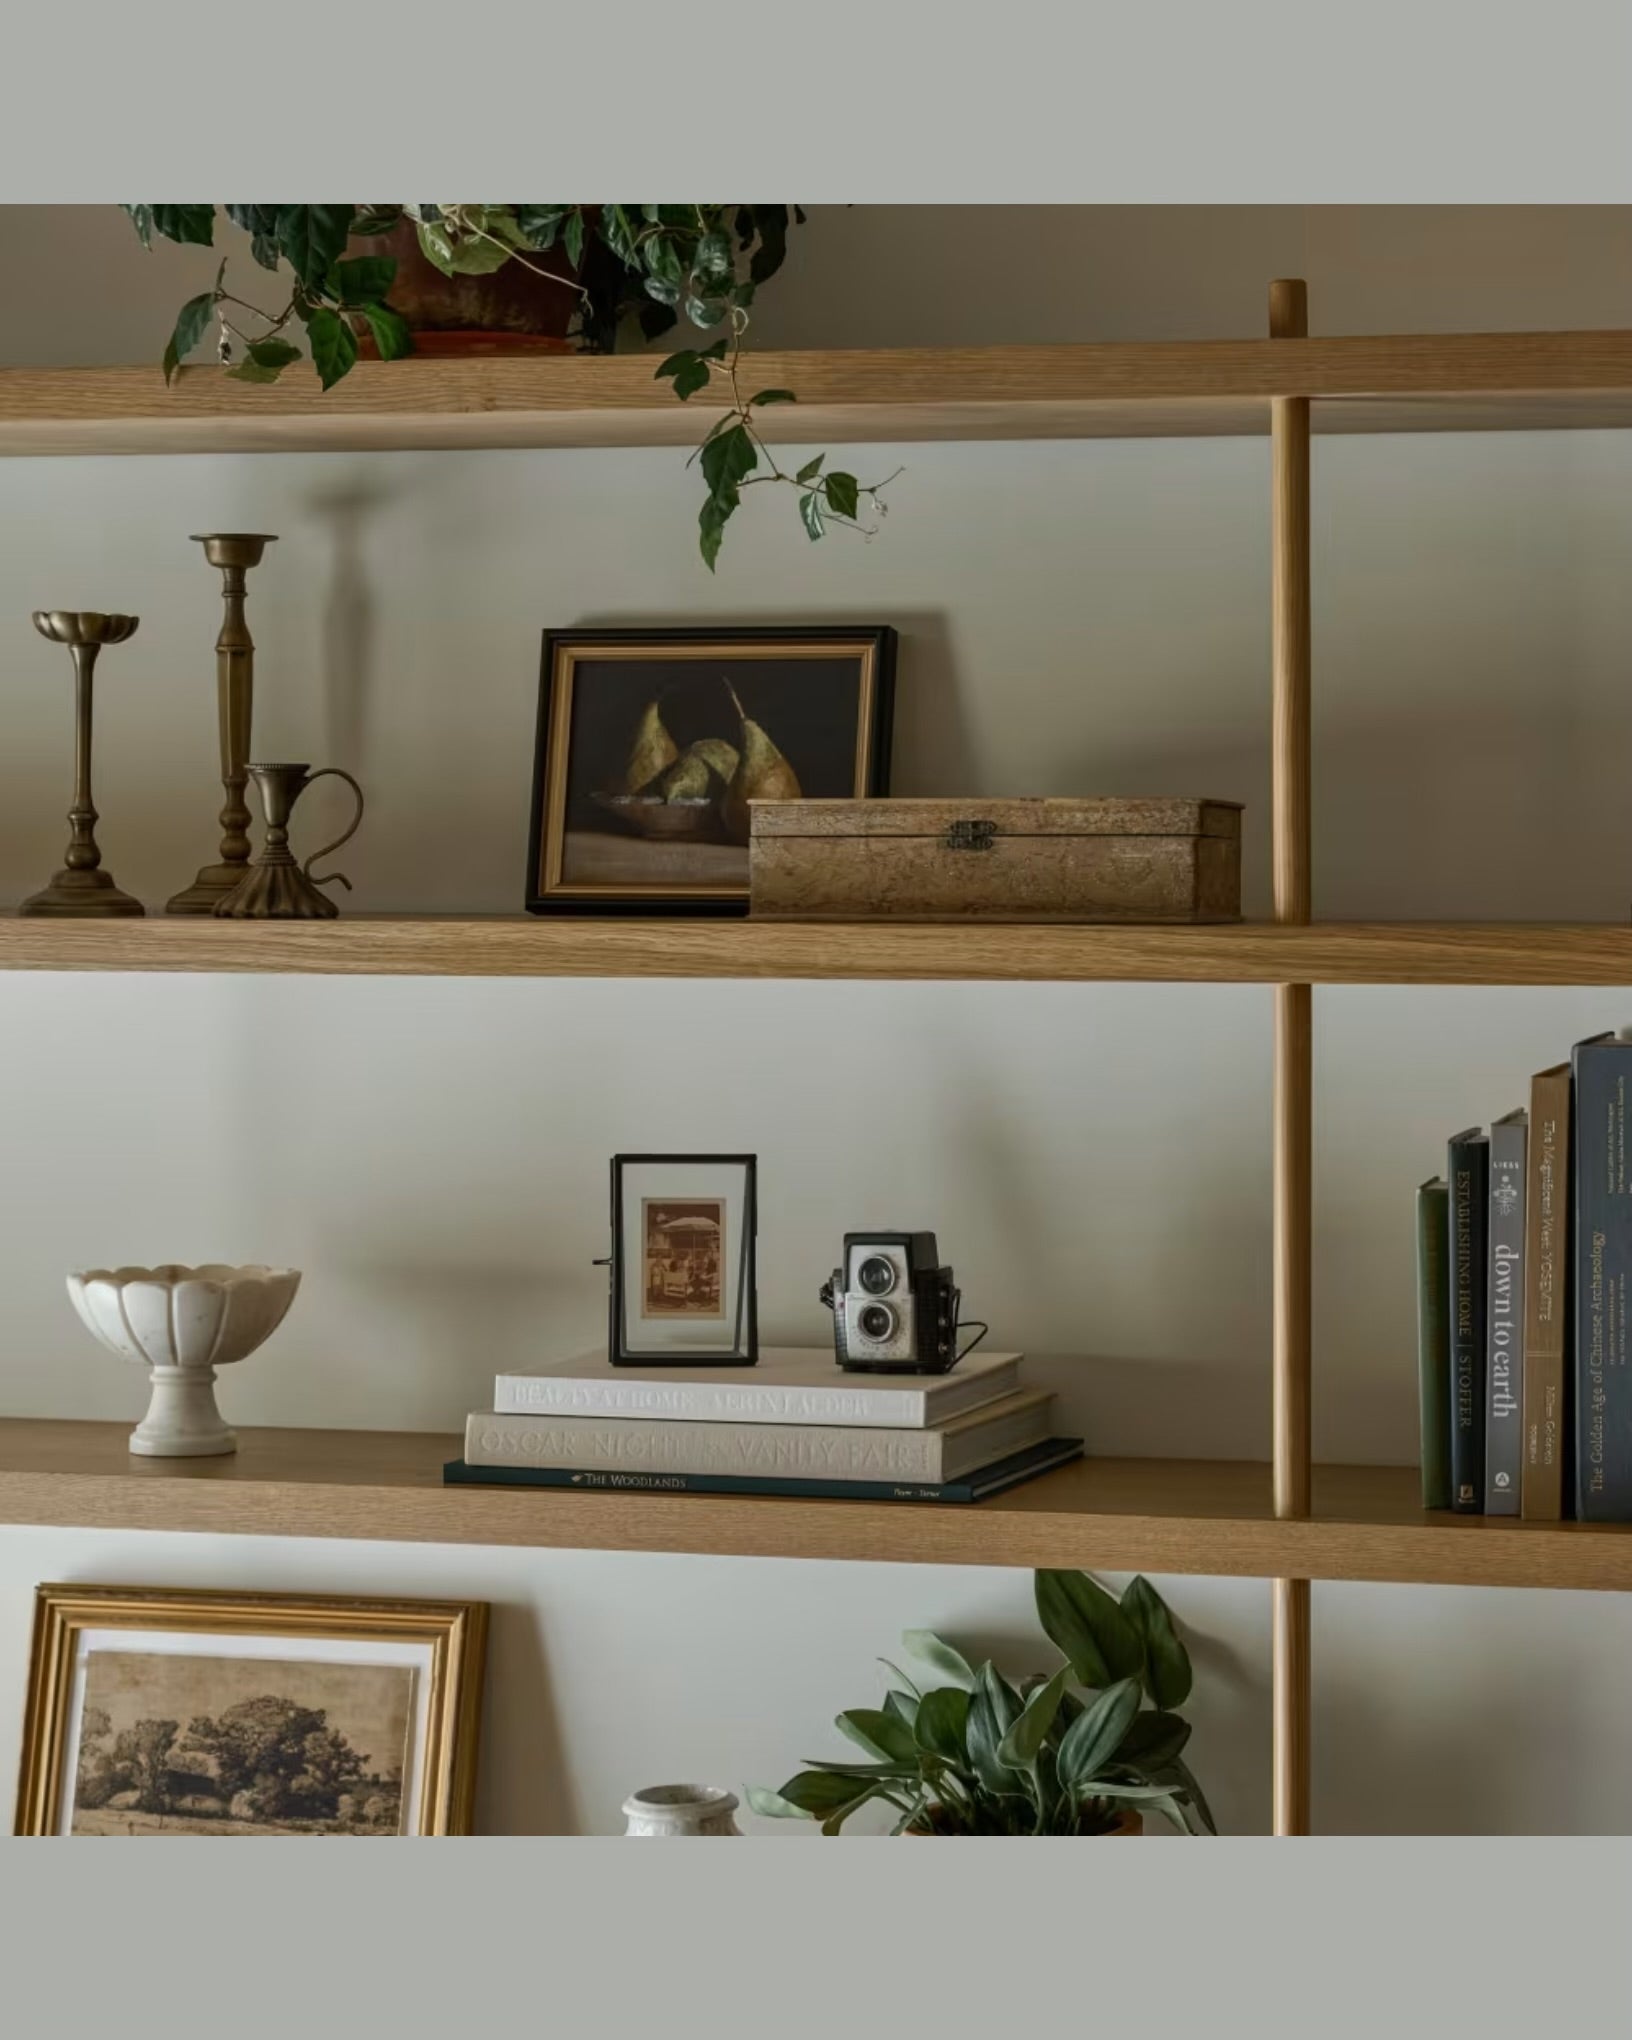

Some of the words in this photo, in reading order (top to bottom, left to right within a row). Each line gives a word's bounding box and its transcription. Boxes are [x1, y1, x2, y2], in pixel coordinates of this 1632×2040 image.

[1457, 1170, 1471, 1286] ESTABLISHING
[1493, 1244, 1519, 1314] down
[1589, 1231, 1606, 1312] Archaeology
[1459, 1289, 1472, 1336] HOME
[1494, 1321, 1515, 1346] to
[1589, 1314, 1603, 1367] Chinese
[515, 1383, 593, 1407] BEAUTY
[600, 1388, 627, 1408] AT
[1459, 1355, 1472, 1428] STOFFER
[1493, 1350, 1518, 1418] earth
[1589, 1369, 1603, 1384] of
[1590, 1387, 1606, 1412] Age
[480, 1430, 579, 1457] OSCAR
[593, 1431, 686, 1459] NIGHT
[737, 1434, 838, 1466] VANITY
[847, 1442, 913, 1469] FAIR
[1589, 1416, 1603, 1463] Golden
[584, 1473, 606, 1486] THE
[610, 1474, 688, 1489] WOODLANDS
[1590, 1467, 1603, 1493] The
